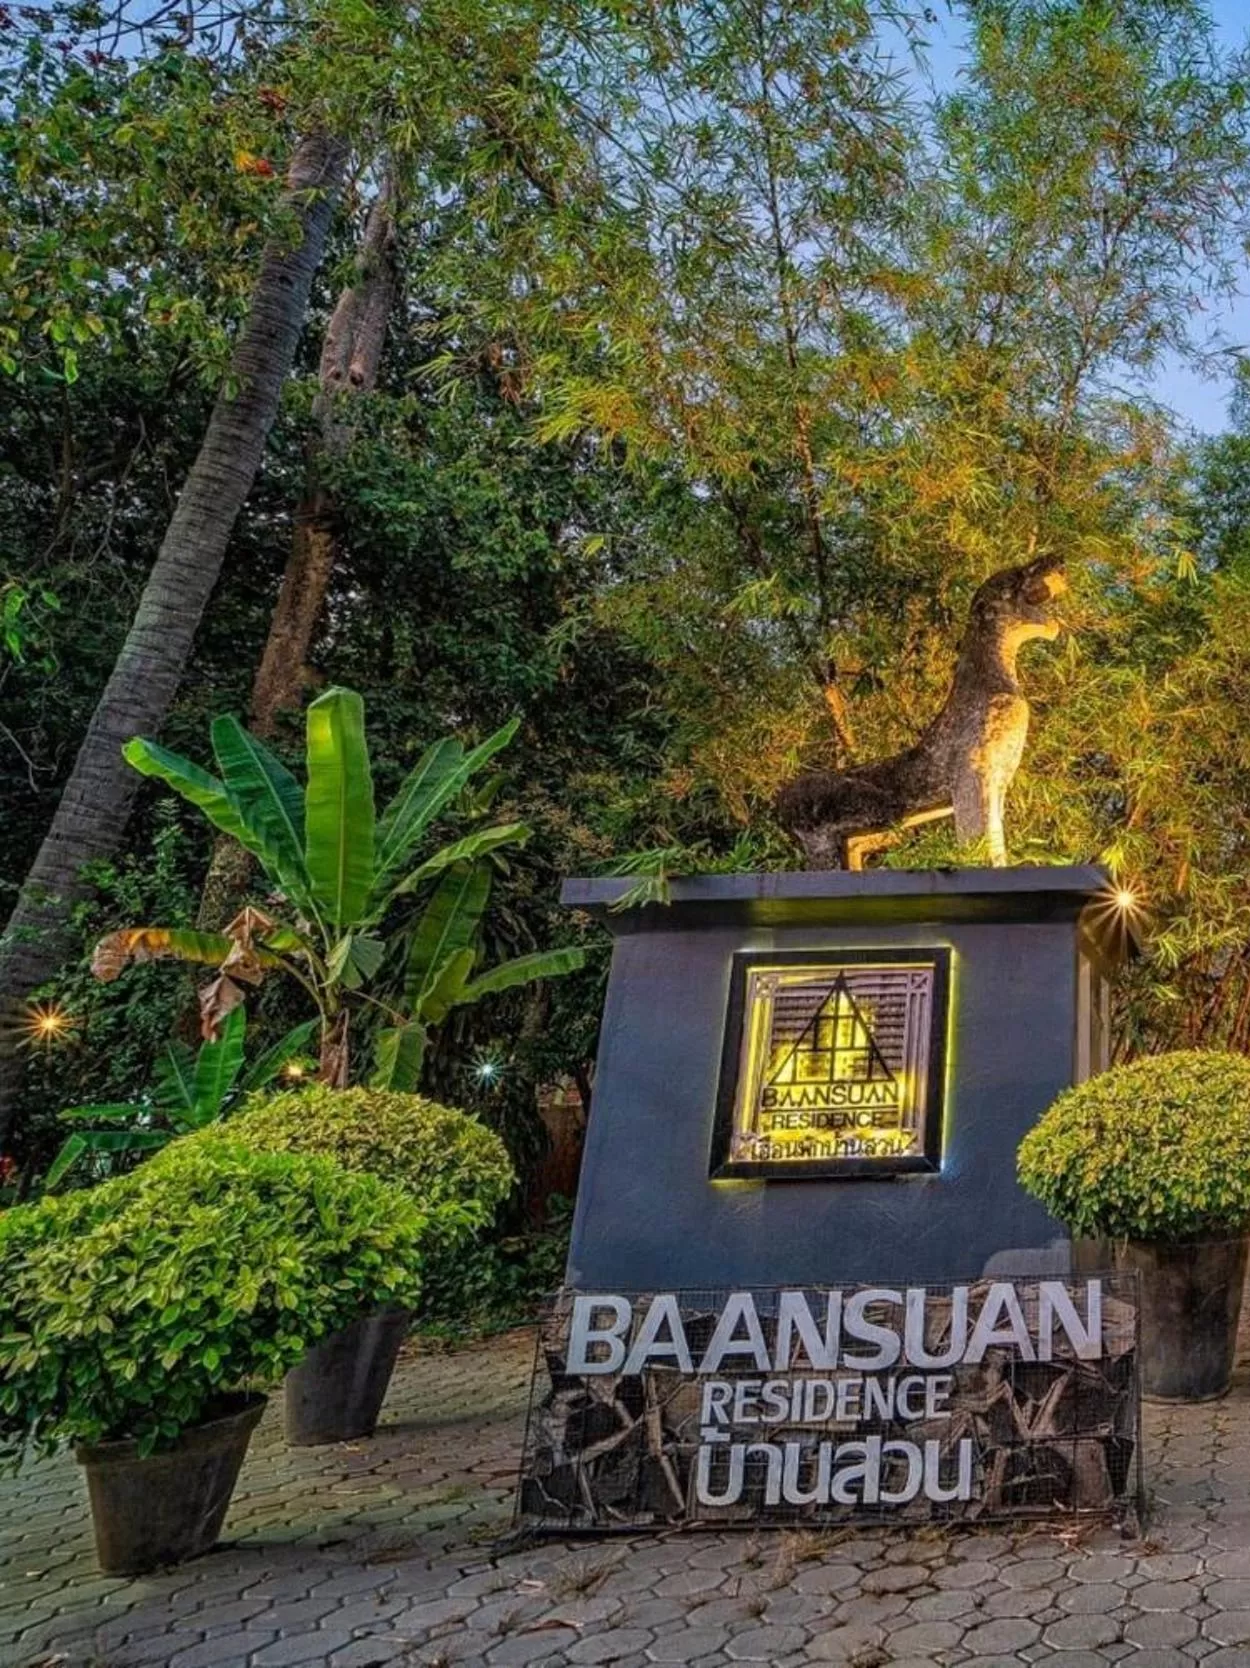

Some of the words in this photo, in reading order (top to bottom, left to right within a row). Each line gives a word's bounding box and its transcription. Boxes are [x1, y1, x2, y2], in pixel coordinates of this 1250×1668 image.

[762, 1083, 898, 1107] BAANSUAN
[771, 1111, 882, 1131] RESIDENCE
[565, 1280, 1102, 1374] BAANSUAN
[702, 1375, 953, 1425] RESIDENCE
[696, 1426, 972, 1506] บ้านสวน
